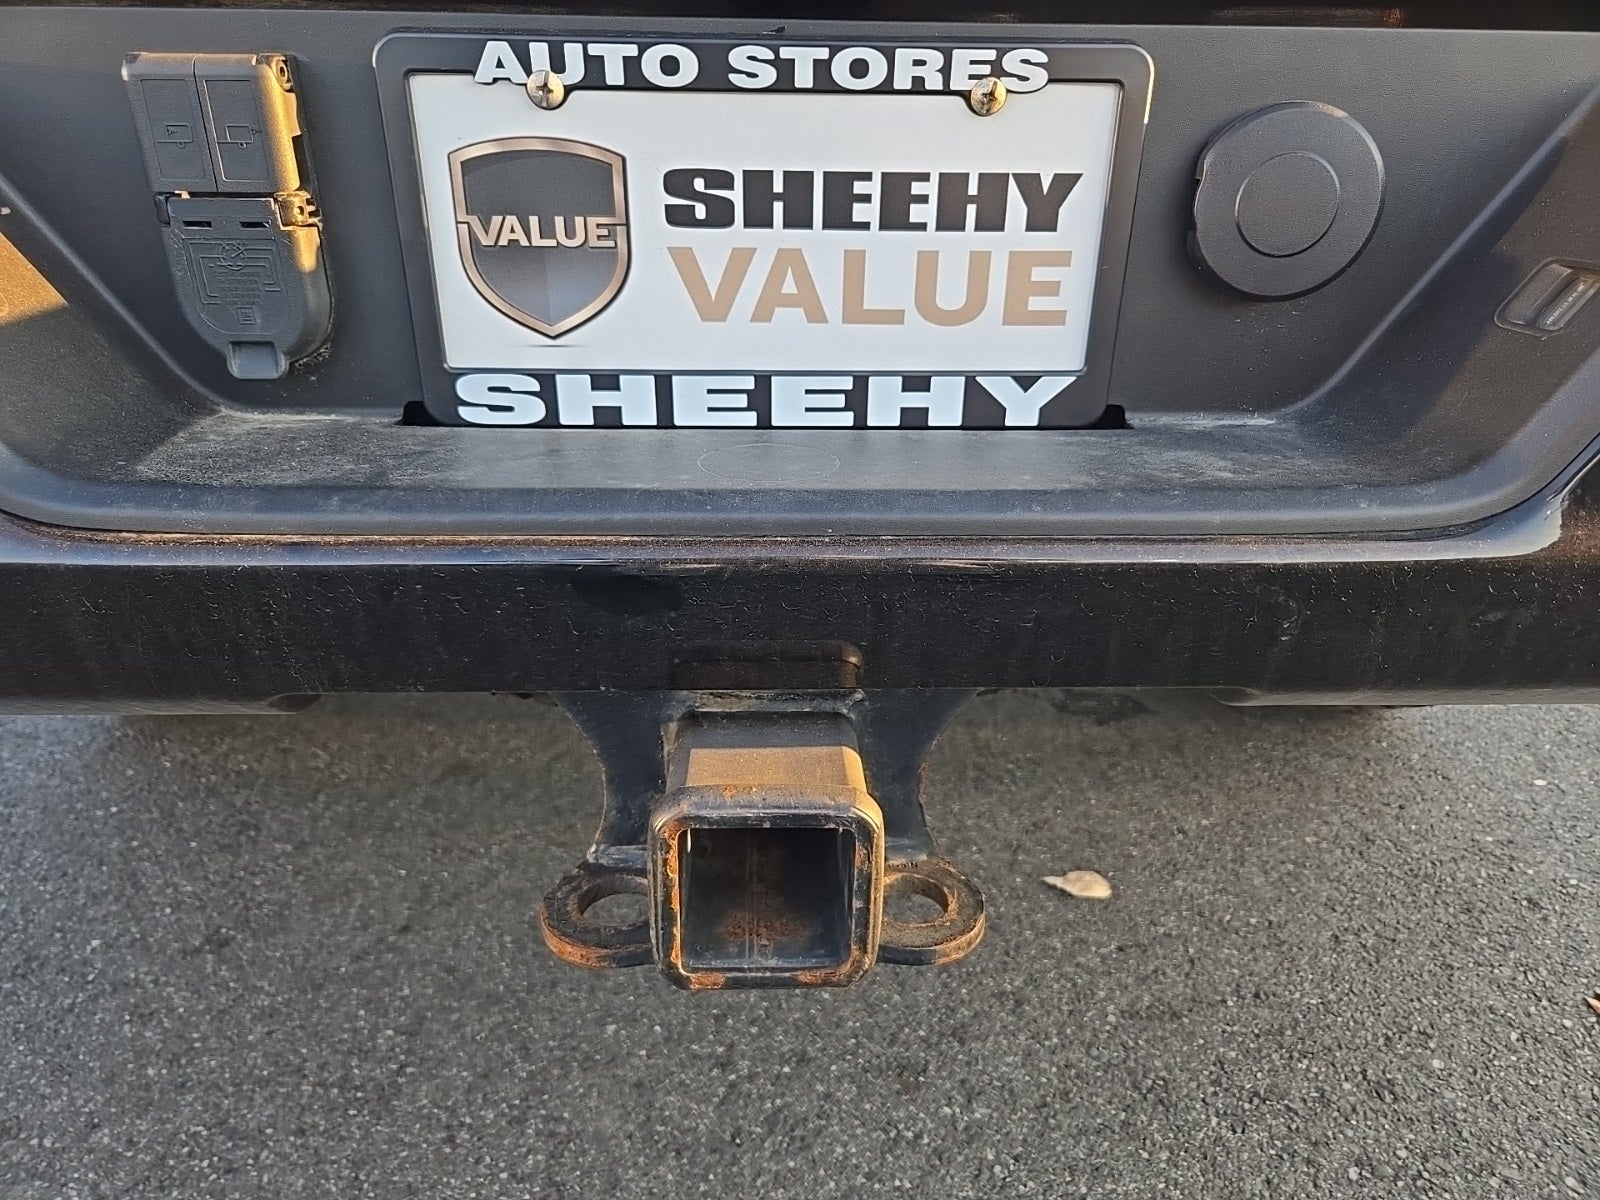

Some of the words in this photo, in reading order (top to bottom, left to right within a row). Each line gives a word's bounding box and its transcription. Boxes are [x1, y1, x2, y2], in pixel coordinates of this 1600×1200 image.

[474, 40, 699, 88] AUTO
[728, 45, 1049, 92] STORES
[663, 168, 1084, 232] SHEEHY
[469, 215, 616, 248] VALUE
[667, 246, 1073, 327] VALUE
[455, 374, 1077, 427] SHEEHY
